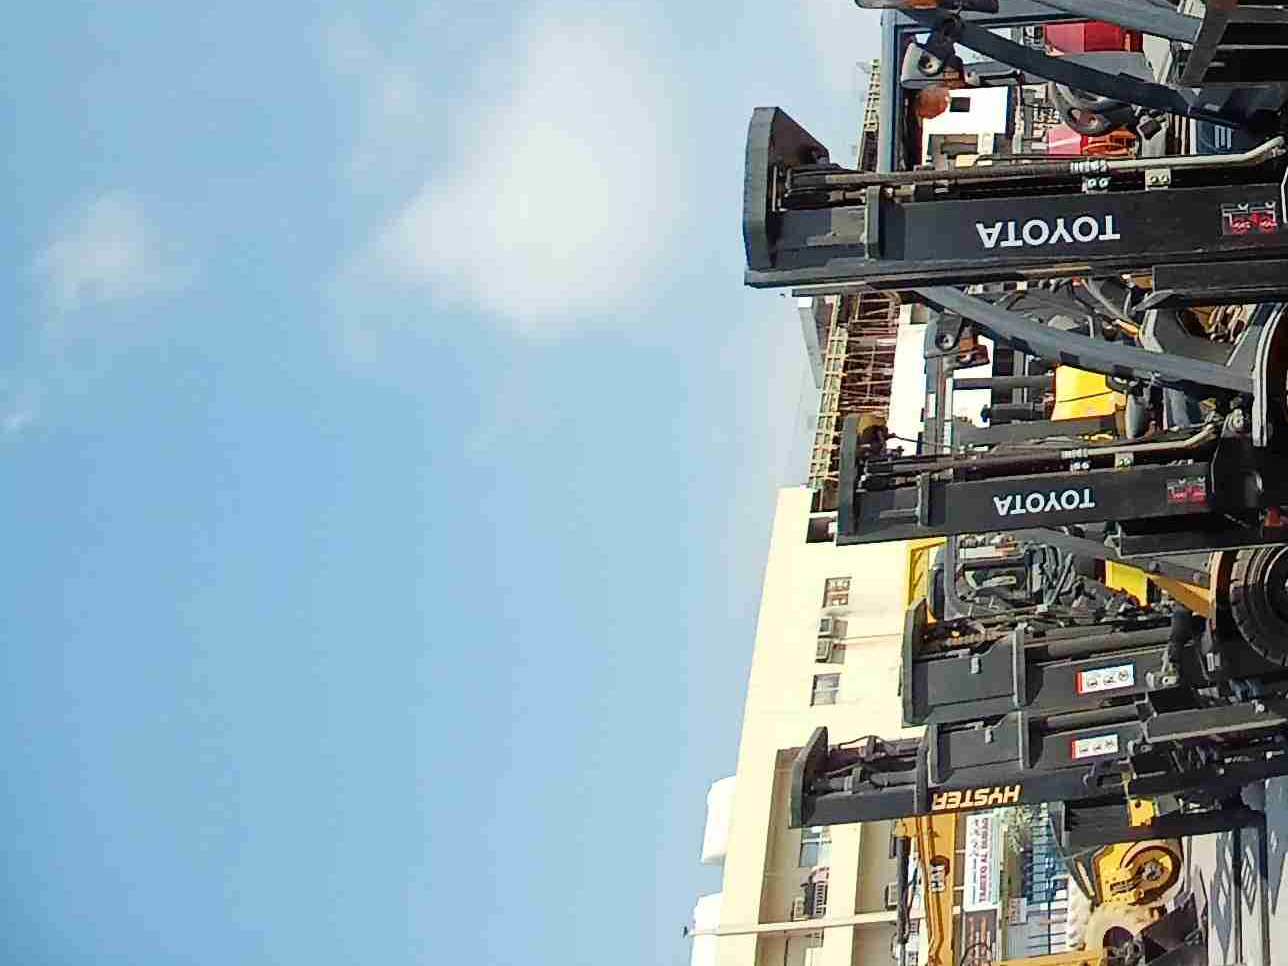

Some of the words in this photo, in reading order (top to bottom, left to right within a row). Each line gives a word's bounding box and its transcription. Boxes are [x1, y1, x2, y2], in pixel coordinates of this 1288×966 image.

[976, 215, 1120, 248] TOYOTA
[993, 488, 1095, 516] TOYOTA
[931, 785, 1020, 810] HYSTER
